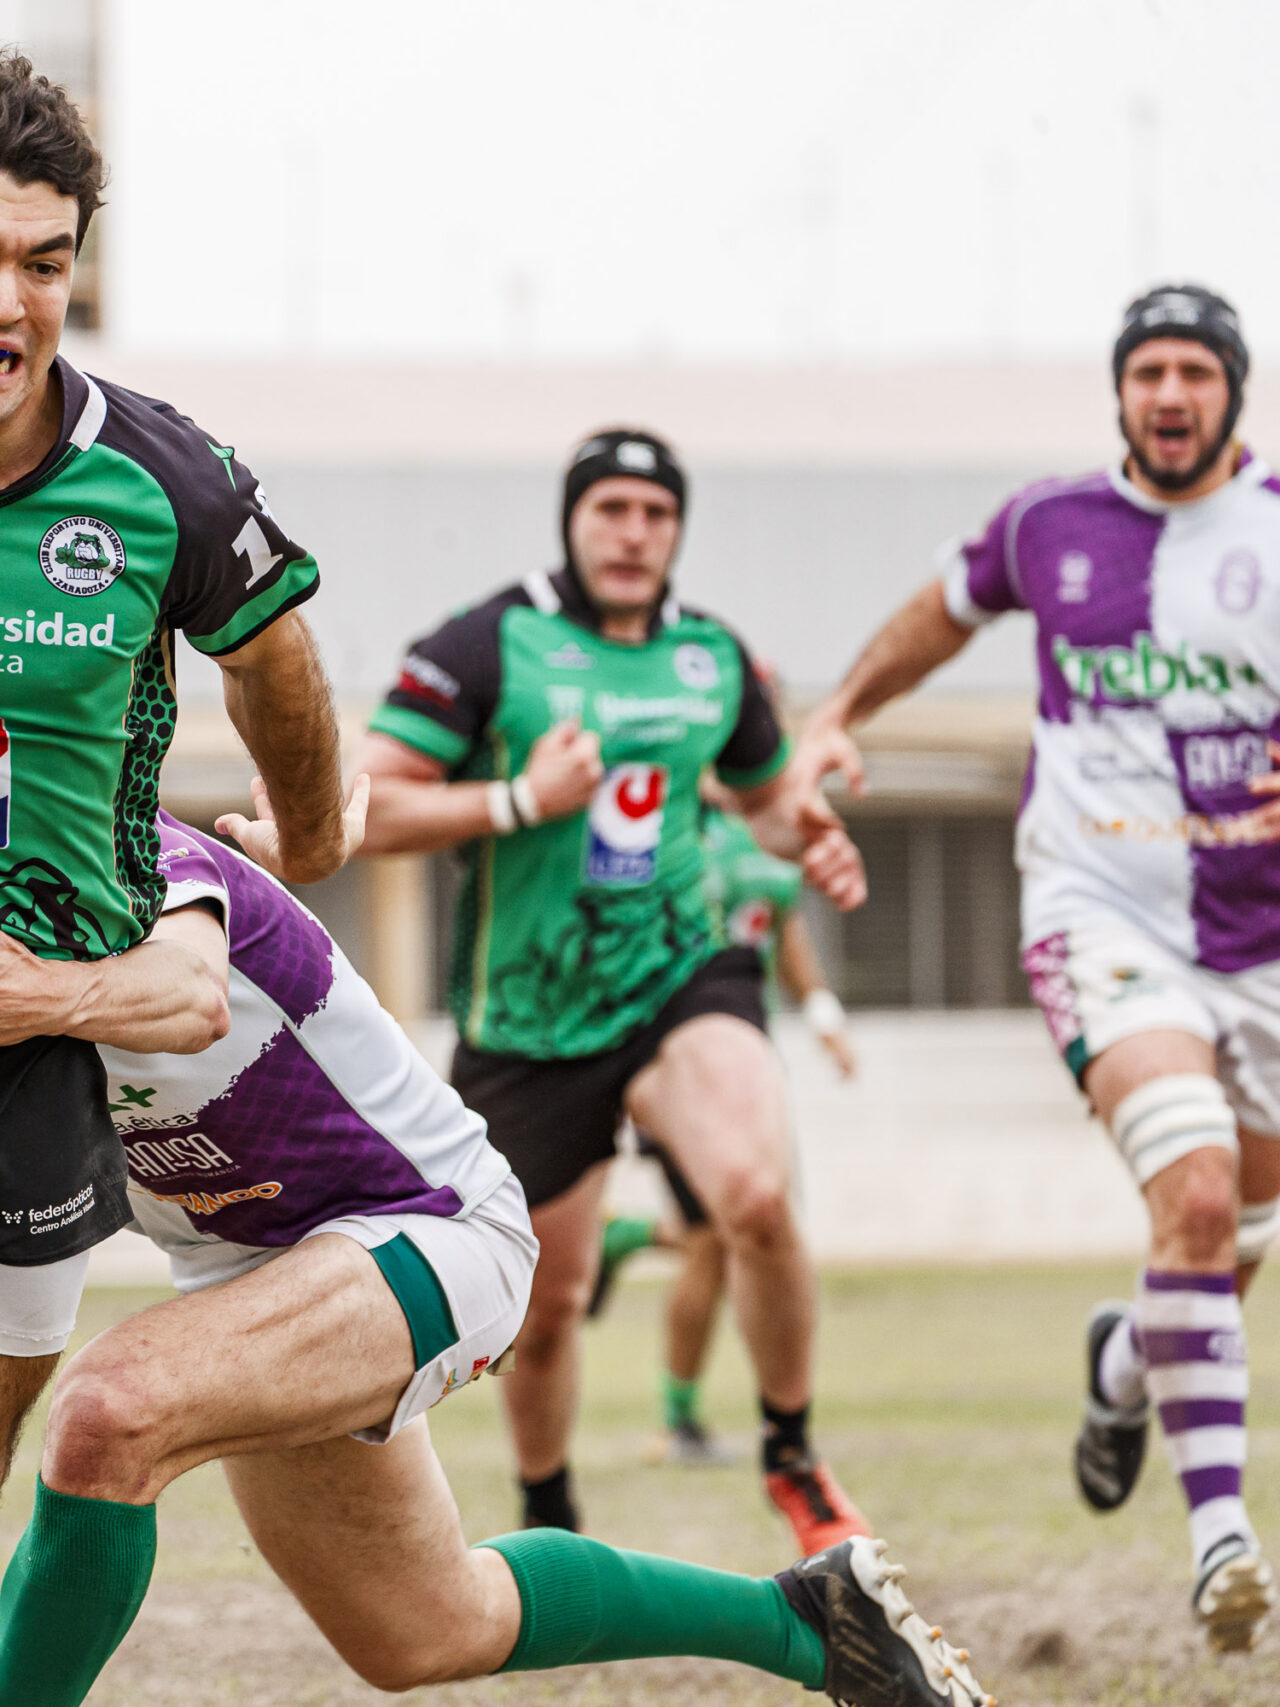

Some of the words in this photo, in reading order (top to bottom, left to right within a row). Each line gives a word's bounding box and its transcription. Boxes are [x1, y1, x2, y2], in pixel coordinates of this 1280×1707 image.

[43, 518, 86, 549] DEPORTIVO
[41, 550, 54, 574] CLUB
[66, 567, 103, 580] RUGBY
[55, 578, 106, 595] ZARAGOZA
[28, 1183, 93, 1223] federópticos
[30, 1222, 60, 1235] Centro
